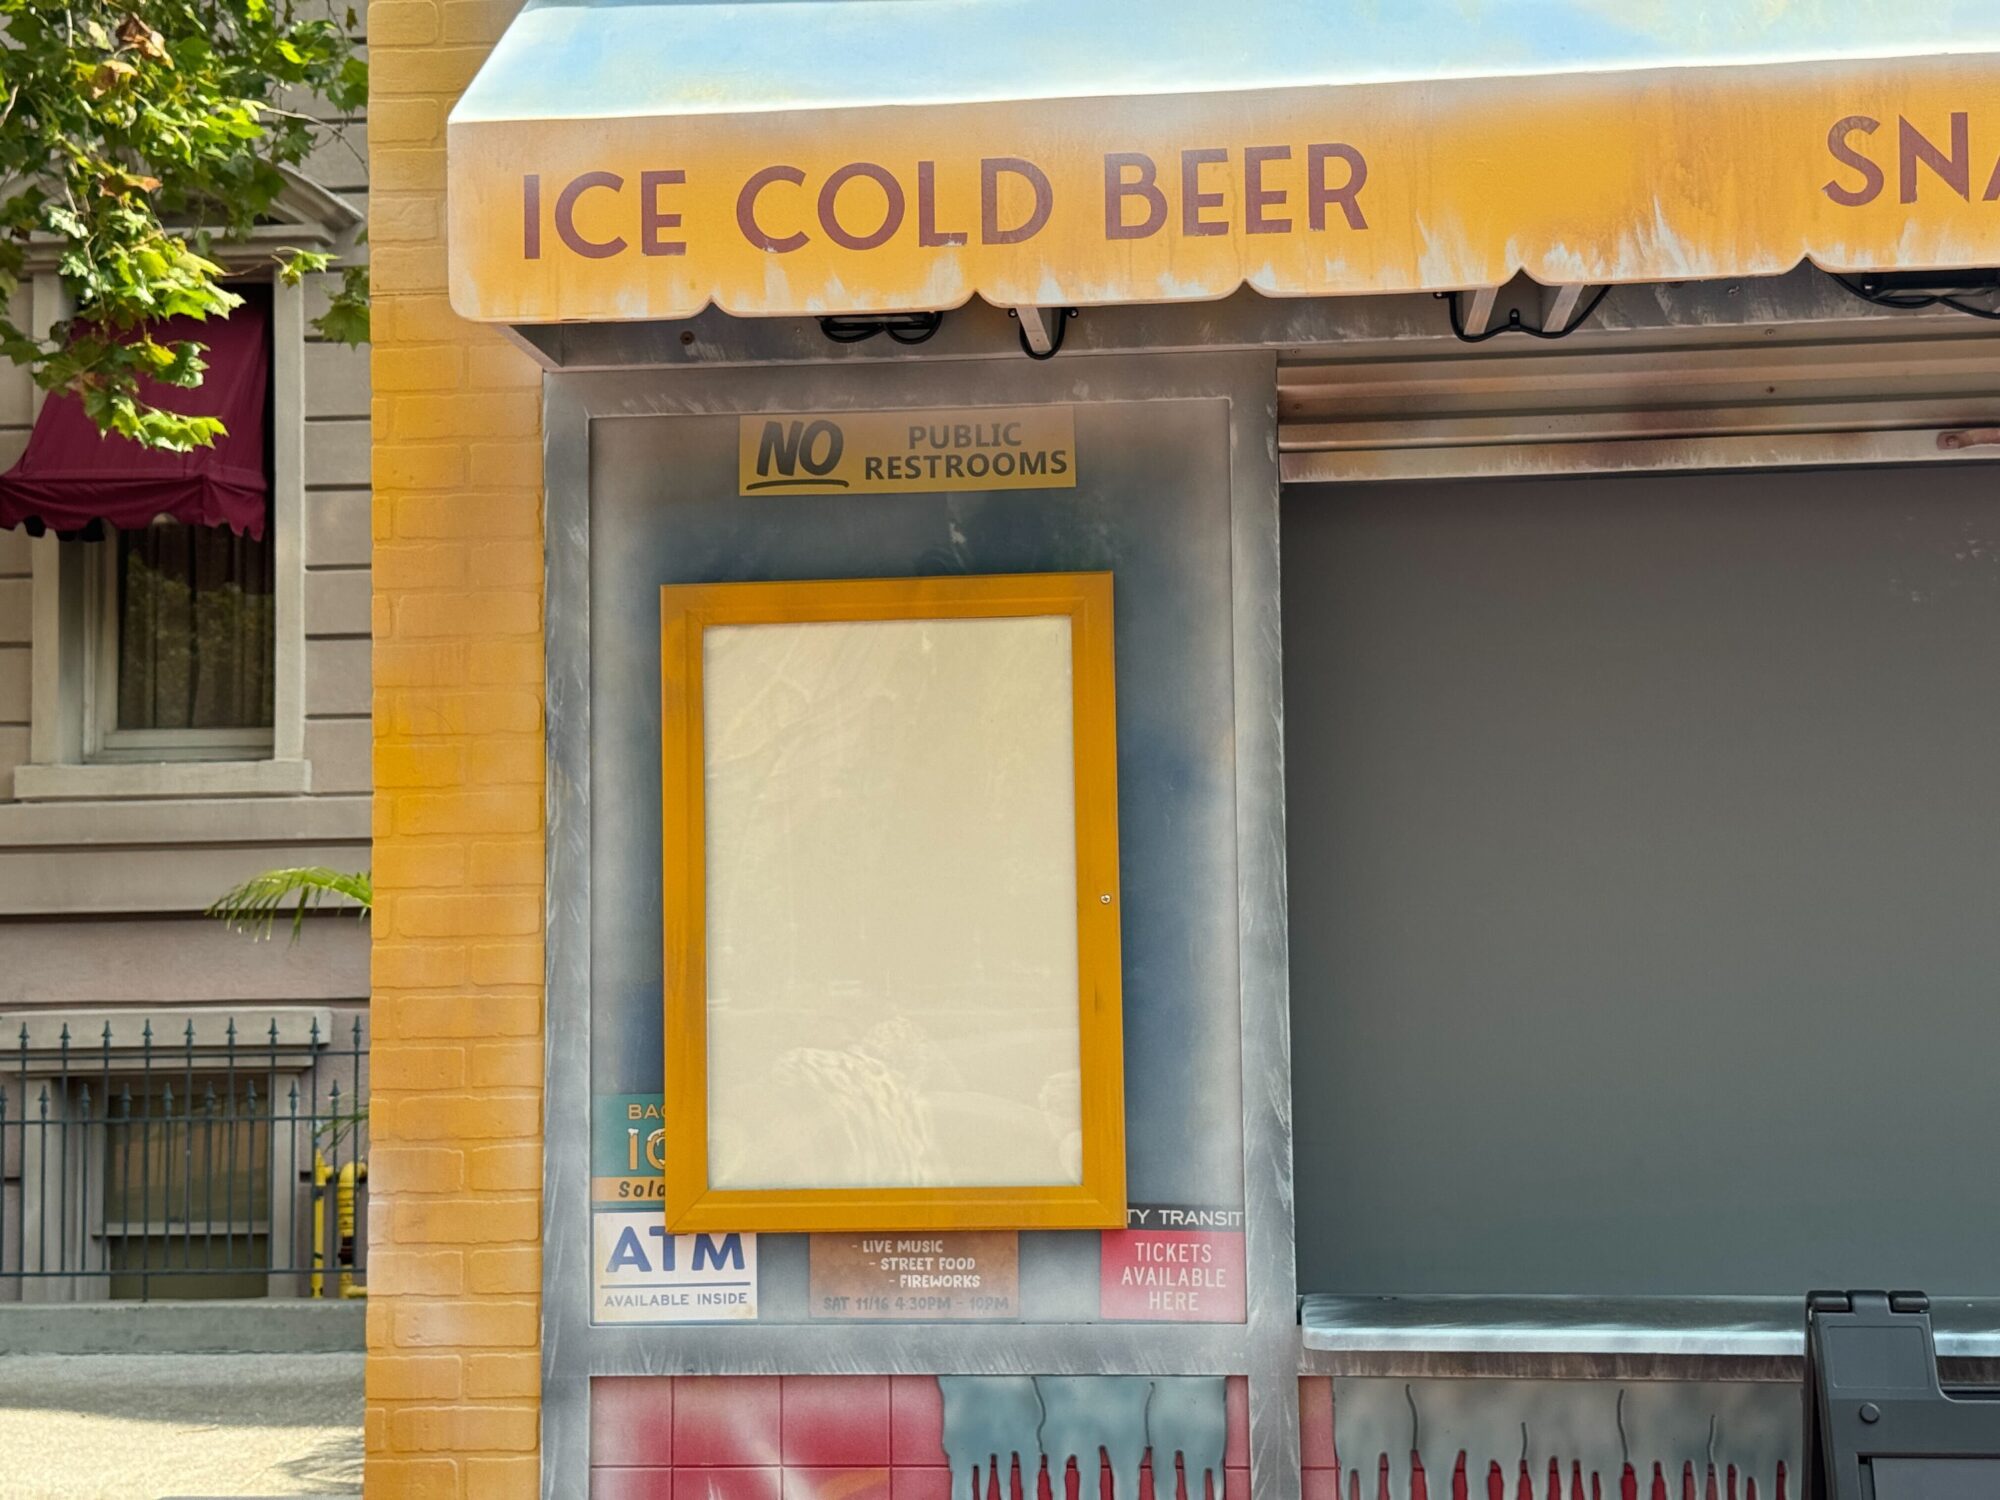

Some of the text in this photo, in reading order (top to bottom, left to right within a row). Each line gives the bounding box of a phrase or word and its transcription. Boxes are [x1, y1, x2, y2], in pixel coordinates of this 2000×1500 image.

[1821, 112, 2000, 207] SN
[522, 142, 1369, 260] ICE COLD BEER
[908, 421, 1023, 450] PUBLIC
[756, 419, 844, 477] NO
[864, 449, 1068, 481] RESTROOMS
[1158, 1209, 1244, 1226] TRANSIT
[604, 1225, 746, 1273] ATM
[862, 1239, 892, 1253] LIVE
[897, 1239, 944, 1253] MUSIC
[1134, 1242, 1213, 1263] TICKETS
[880, 1257, 934, 1271] STREET
[938, 1257, 976, 1270] FOOD
[899, 1274, 981, 1288] FIREWORKS
[1120, 1266, 1227, 1288] AVAILABLE
[604, 1292, 748, 1307] AVAILABLE INSIDE
[823, 1297, 850, 1311] SAT
[856, 1296, 889, 1311] 11/16
[894, 1296, 951, 1310] 4:30PM
[969, 1296, 1009, 1310] 10PM
[1148, 1291, 1199, 1311] HERE
